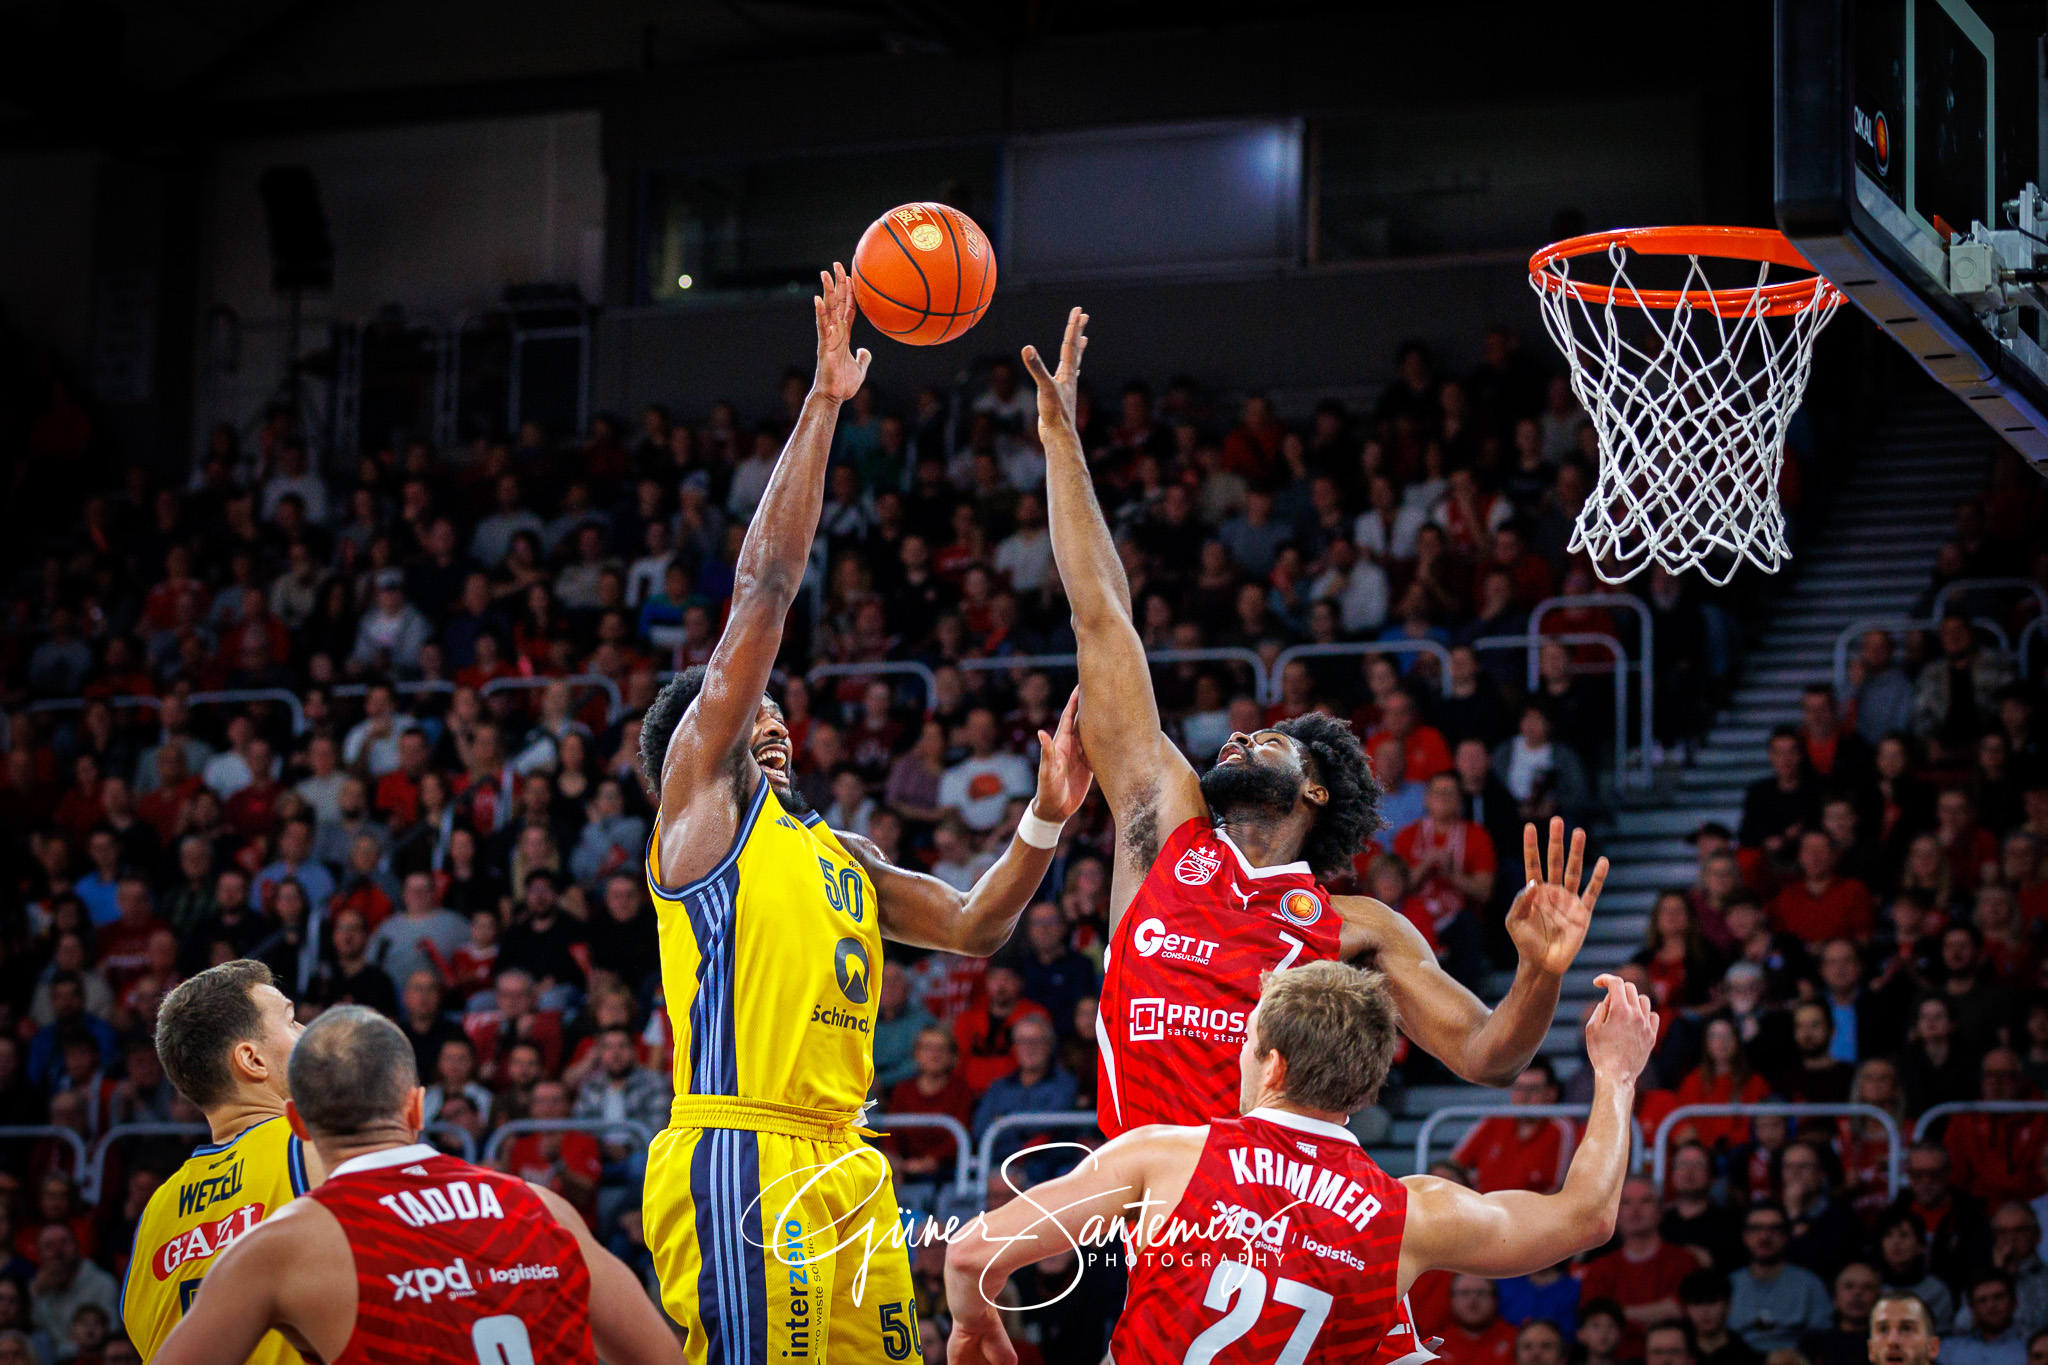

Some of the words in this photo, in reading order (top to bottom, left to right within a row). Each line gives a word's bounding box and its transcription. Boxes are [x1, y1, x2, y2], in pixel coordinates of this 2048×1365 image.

[818, 856, 863, 923] 50
[1161, 950, 1209, 965] CONSULTING
[1197, 941, 1219, 959] IT
[1268, 930, 1304, 982] 7
[1167, 1004, 1248, 1033] PRIOS
[1167, 1027, 1209, 1040] safety
[379, 1181, 504, 1227] TADDA
[1228, 1147, 1382, 1232] KRIMMER
[1214, 1200, 1290, 1246] xpd
[1302, 1235, 1365, 1271] logistics
[1255, 1239, 1282, 1254] global
[387, 1257, 473, 1304] xpd
[489, 1263, 559, 1284] logistics
[815, 1286, 823, 1326] waste
[1182, 1260, 1334, 1365] 27
